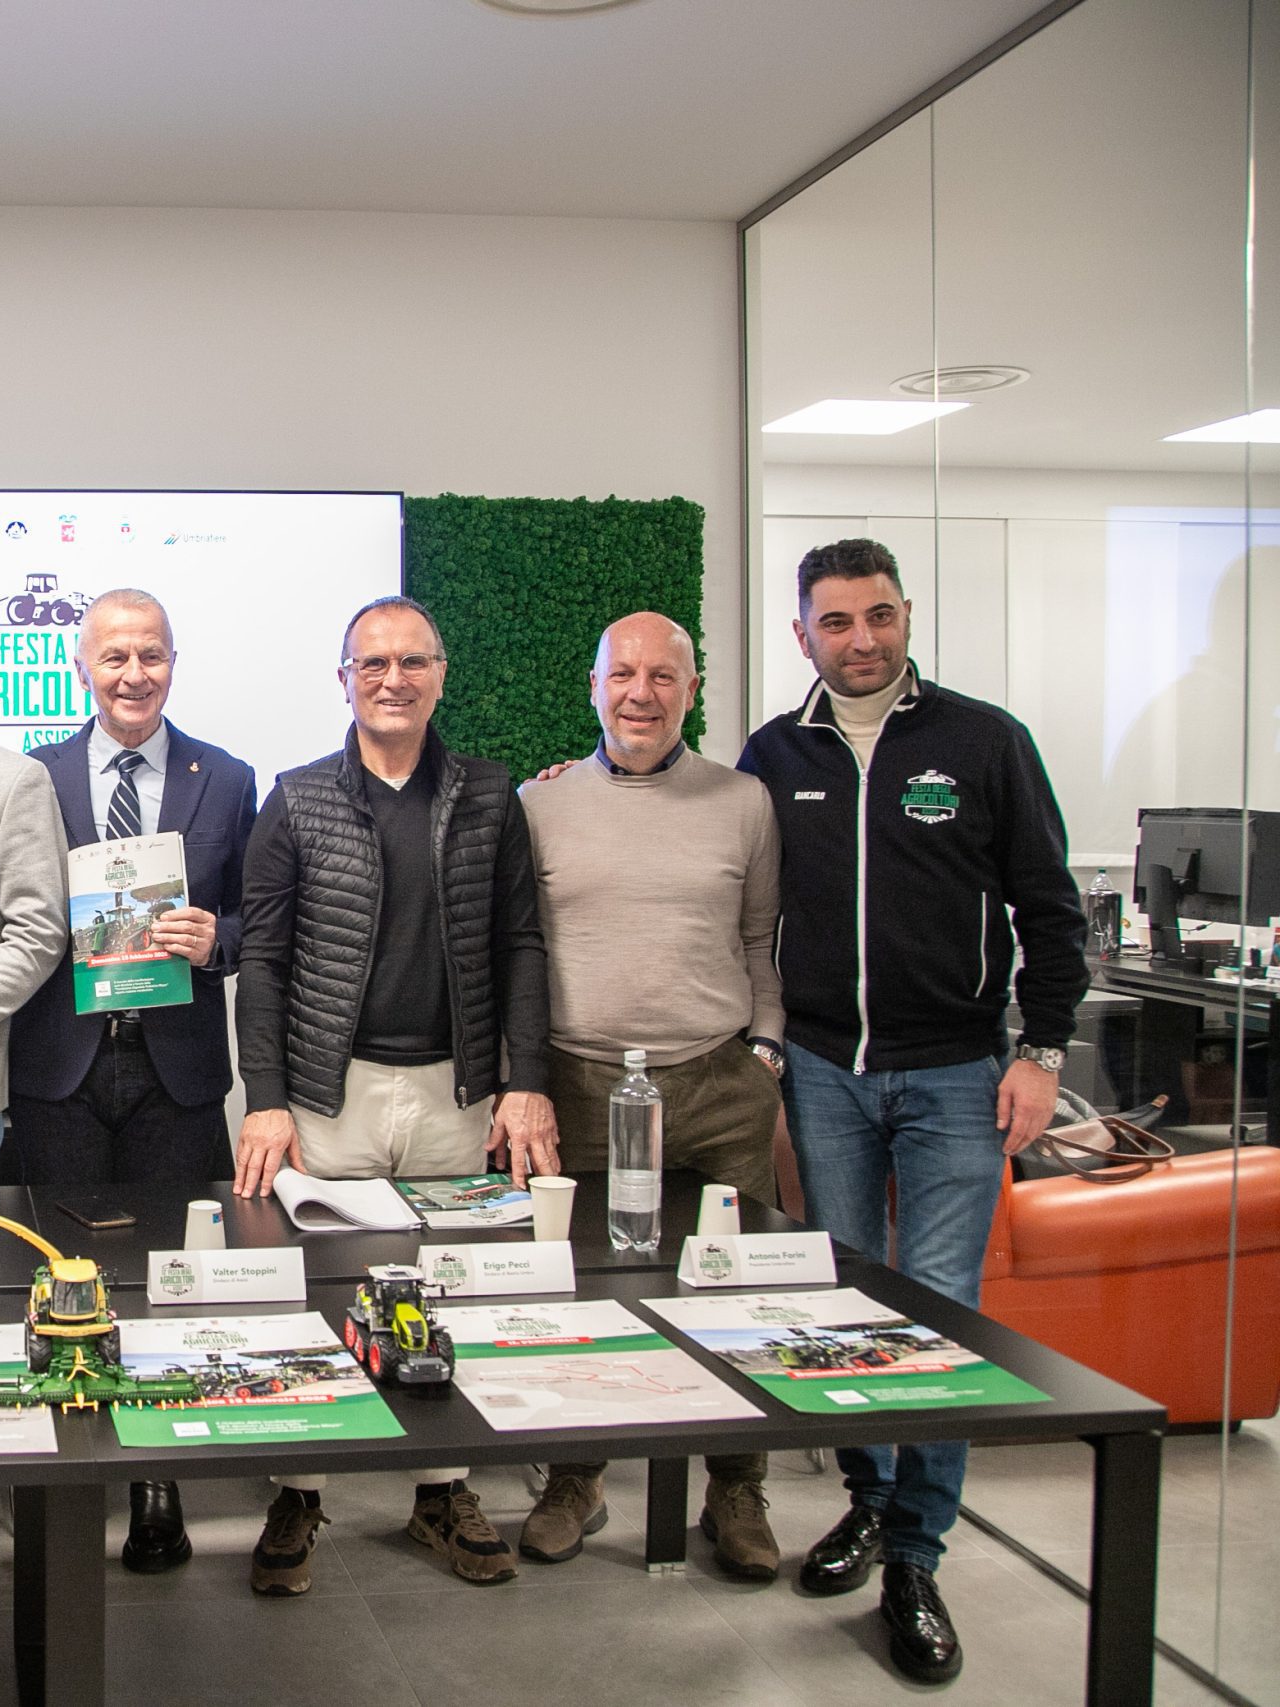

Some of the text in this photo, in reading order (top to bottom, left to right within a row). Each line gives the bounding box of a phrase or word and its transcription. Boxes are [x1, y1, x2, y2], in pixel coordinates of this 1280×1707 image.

[0, 633, 67, 665] FESTA
[911, 784, 931, 793] FESTA
[900, 793, 960, 808] AGRICOLTORI
[748, 1252, 781, 1261] Antonio
[483, 1260, 531, 1271] Erigo Pecci
[212, 1266, 278, 1277] Valter Stoppini
